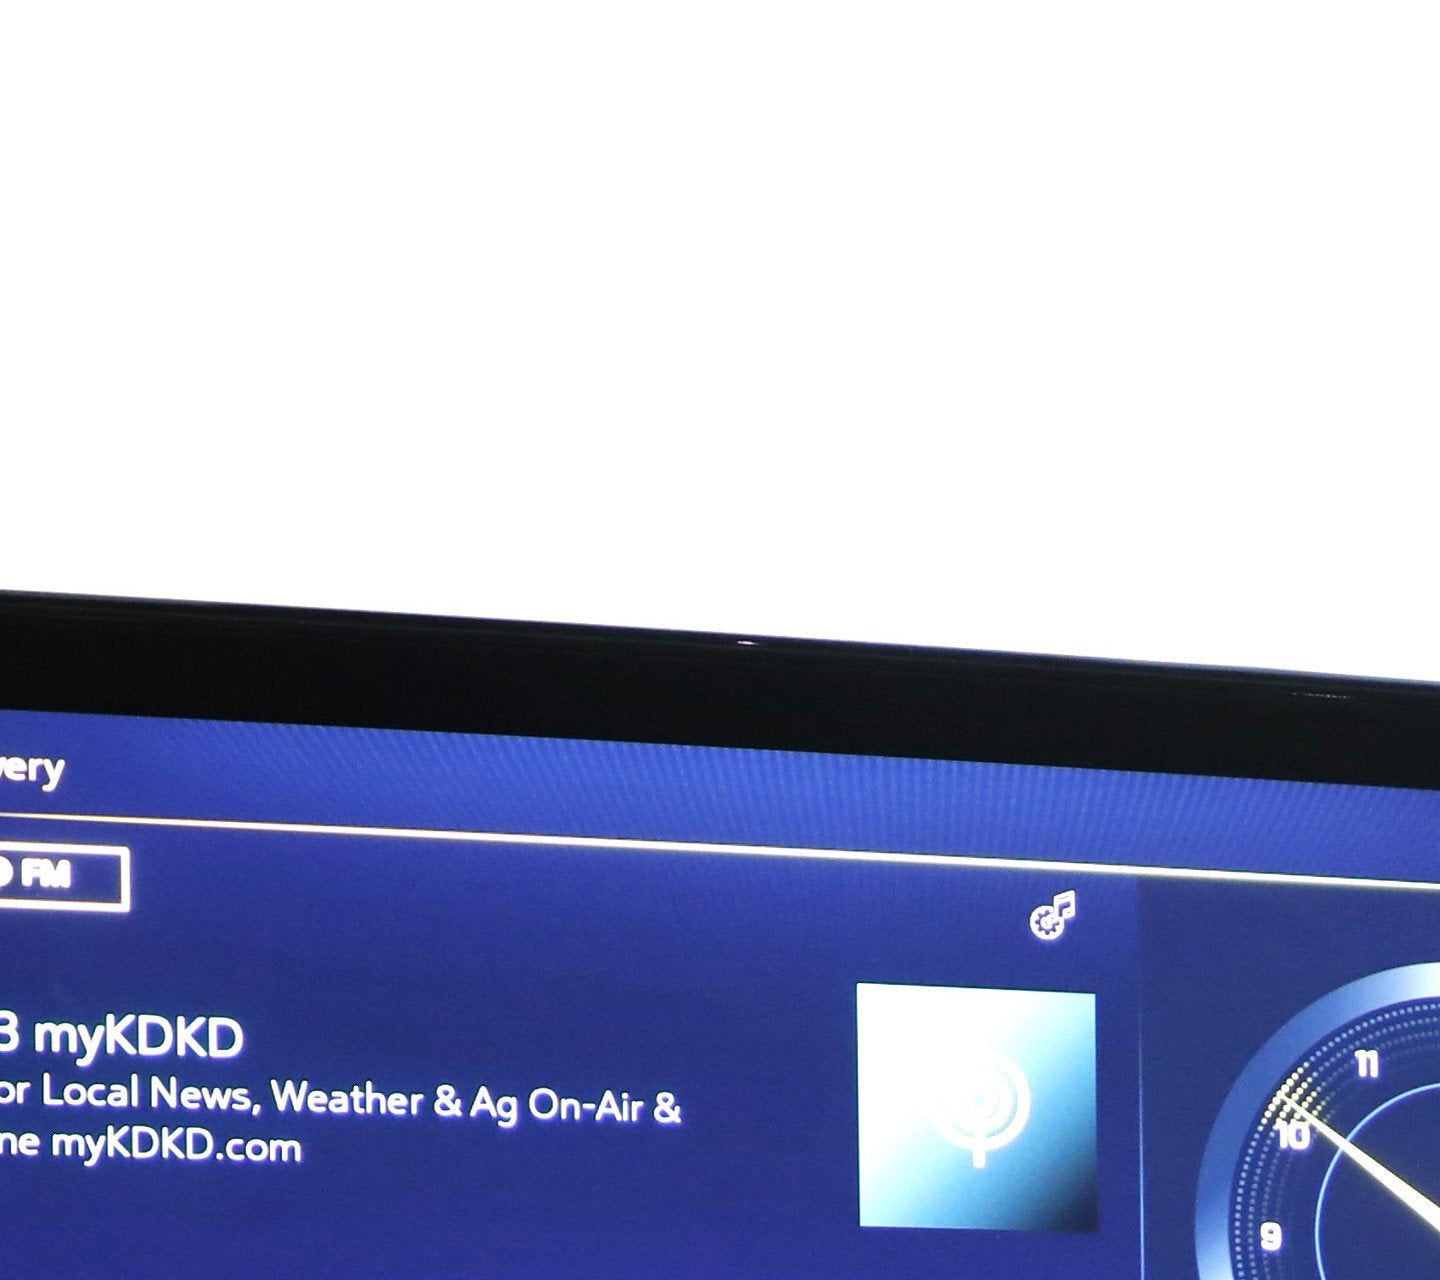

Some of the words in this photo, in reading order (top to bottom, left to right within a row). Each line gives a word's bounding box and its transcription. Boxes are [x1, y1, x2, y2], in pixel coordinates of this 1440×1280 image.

[21, 857, 72, 889] FM
[34, 1013, 244, 1068] myKDKD
[1354, 1049, 1379, 1079] 11
[43, 1072, 139, 1108] Local
[151, 1075, 262, 1117] News,
[270, 1079, 425, 1116] Weather
[433, 1084, 463, 1118] &
[469, 1085, 518, 1129] Ag
[528, 1087, 645, 1122] On-Air
[653, 1091, 682, 1124] &
[52, 1124, 302, 1168] myKDKD.com
[1278, 1121, 1311, 1151] 10
[1260, 1221, 1283, 1252] 9
